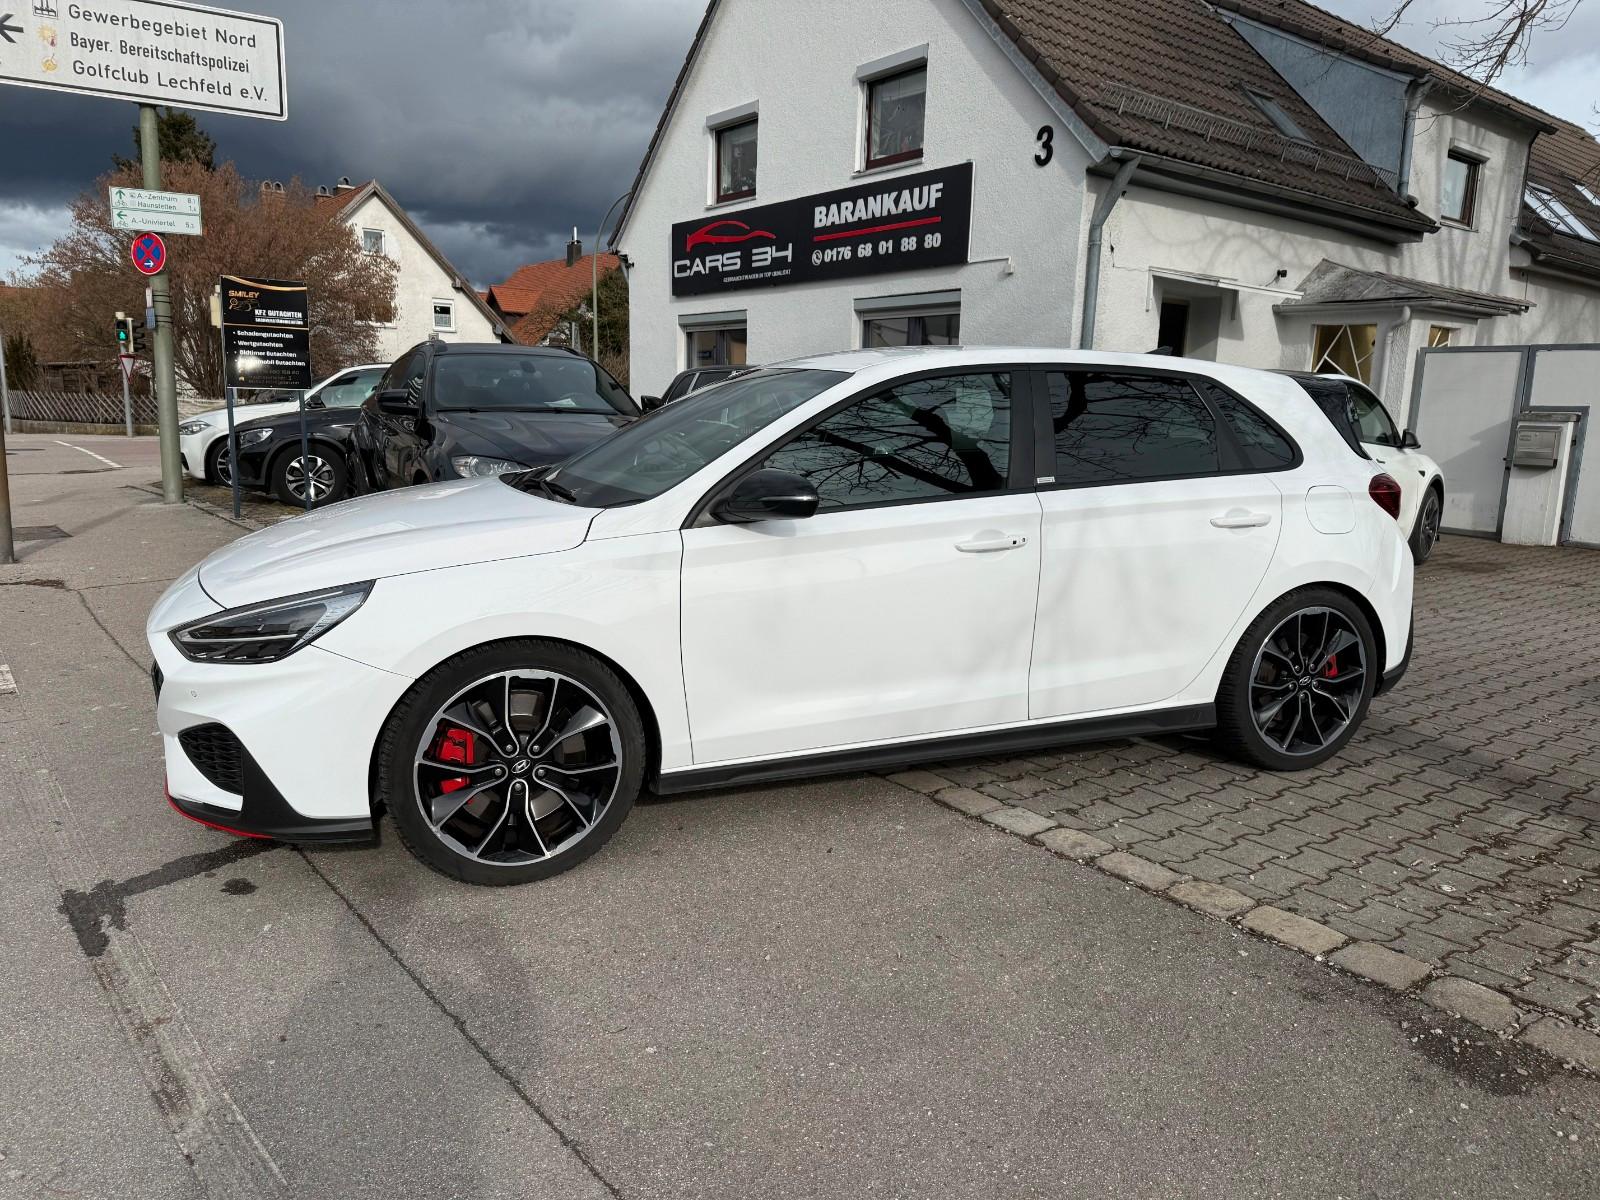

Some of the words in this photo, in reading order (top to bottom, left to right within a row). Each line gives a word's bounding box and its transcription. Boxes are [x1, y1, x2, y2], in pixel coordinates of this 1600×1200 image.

[68, 4, 207, 40] Gewerbegebiet
[215, 28, 256, 48] Nord
[70, 31, 113, 53] Bayer.
[119, 39, 250, 73] Bereitschaftspolizei
[72, 59, 149, 84] Golfclub
[157, 71, 232, 97] Lechfeld
[240, 85, 268, 102] e.V.
[1035, 125, 1053, 167] 3
[136, 192, 178, 202] A.-Zentrum
[814, 182, 943, 229] BARANKAUF
[674, 251, 741, 278] CARS
[751, 242, 793, 268] 34
[823, 246, 852, 263] 0176
[857, 242, 873, 258] 68
[878, 239, 893, 255] 01
[900, 236, 917, 252] 88
[923, 232, 942, 249] 80
[228, 290, 260, 298] SMILEY
[254, 308, 267, 316] KFZ
[267, 309, 303, 318] GUTACHTEN
[237, 330, 294, 339] Schadengutachten
[238, 340, 284, 348] Wertgutachten
